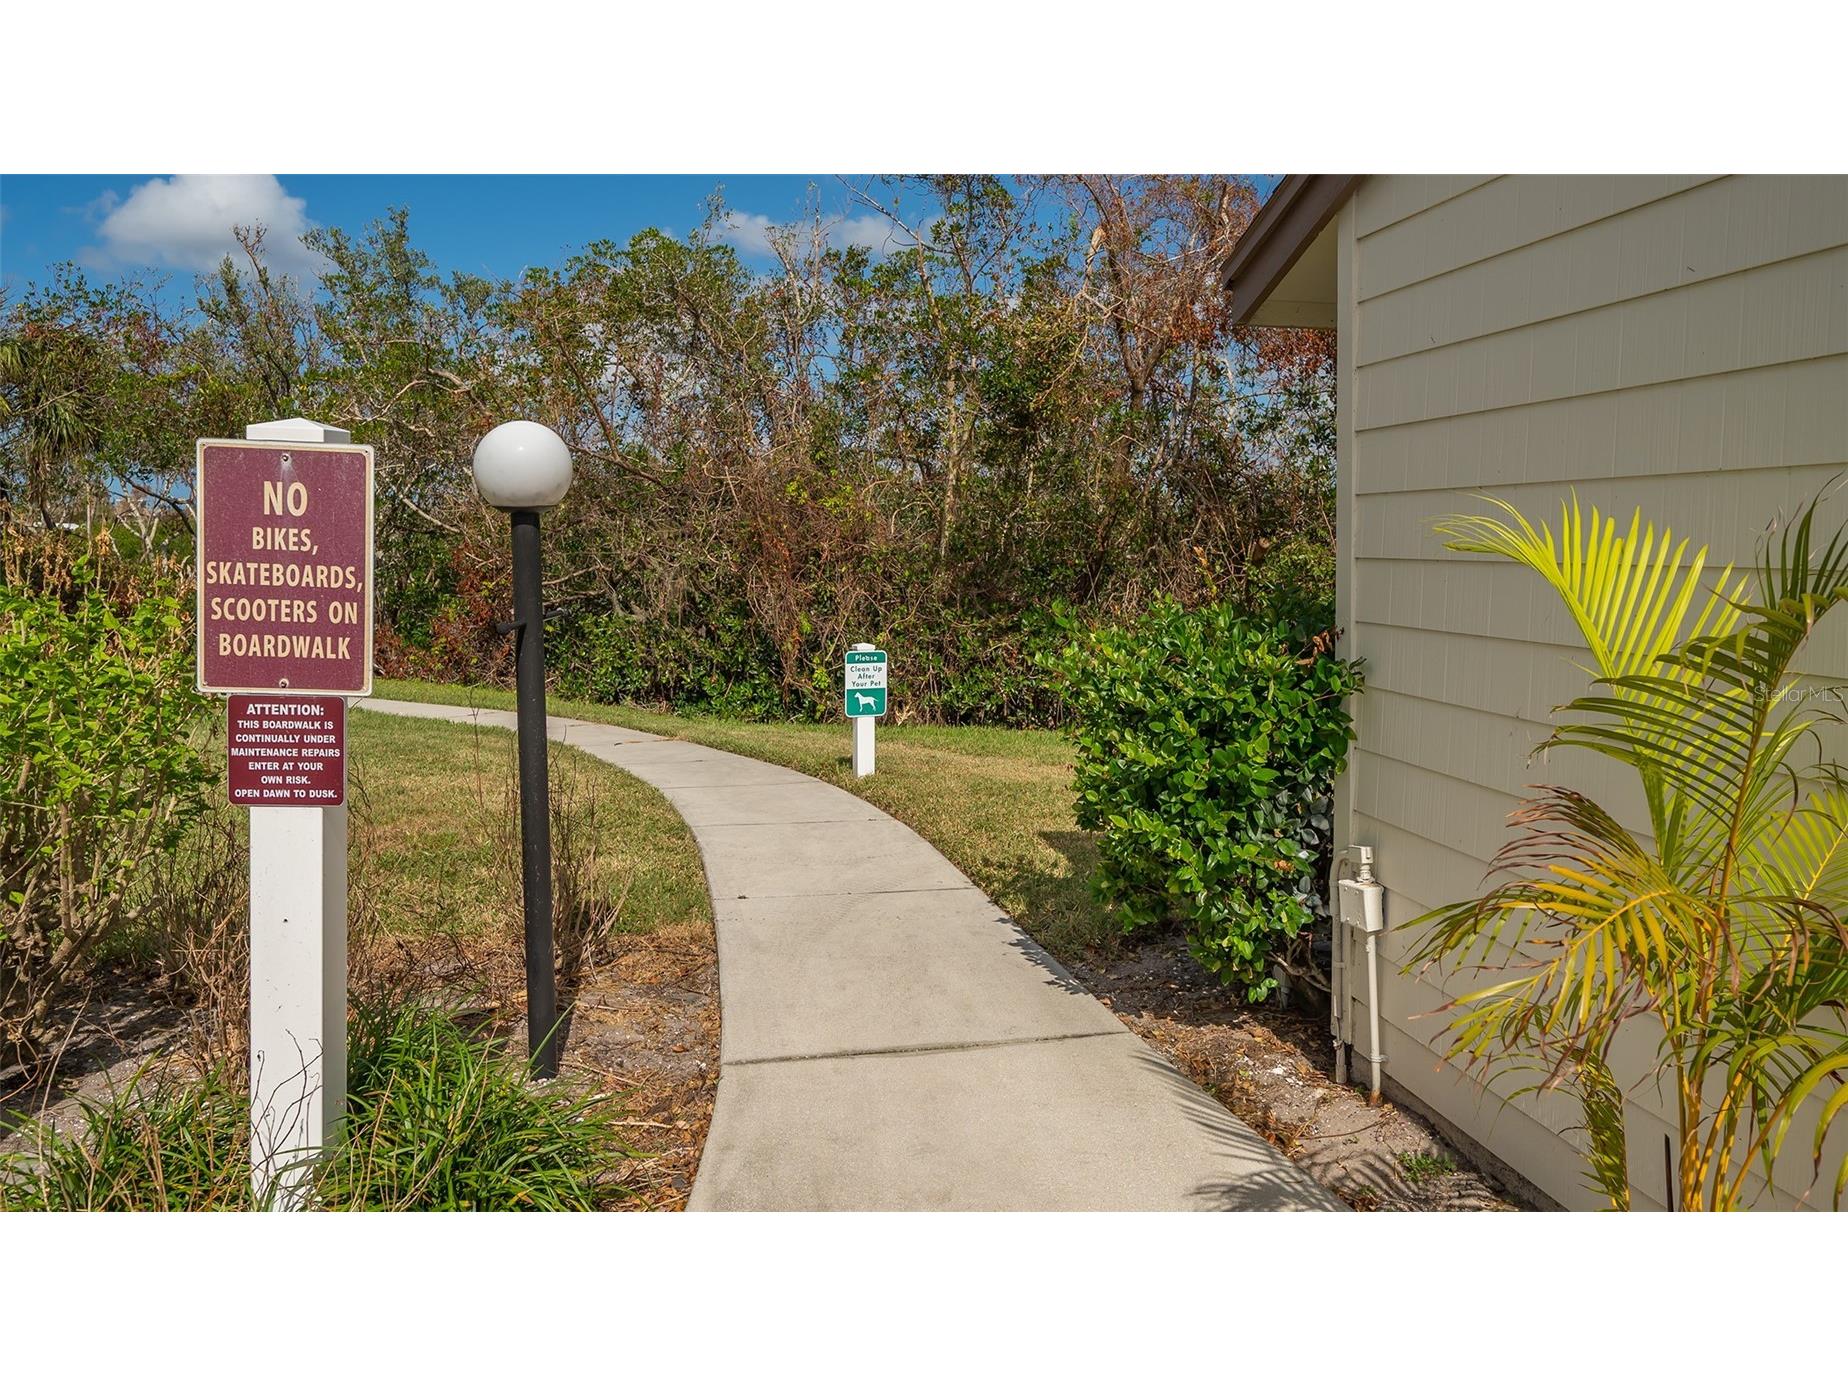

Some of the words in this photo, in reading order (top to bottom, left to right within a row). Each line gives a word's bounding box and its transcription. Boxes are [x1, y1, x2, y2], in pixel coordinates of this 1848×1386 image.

[263, 481, 307, 517] NO
[252, 527, 318, 555] BIKES,
[206, 561, 363, 592] SKATEBOARDS,
[211, 598, 317, 623] SCOOTERS
[328, 601, 358, 624] ON
[218, 633, 351, 659] BOARDWALK
[246, 704, 324, 715] ATTENTION:
[237, 720, 259, 728] THIS
[262, 721, 321, 729] BOARDWALK
[324, 721, 333, 729] IS
[235, 734, 300, 743] CONTINUALLY
[303, 735, 336, 743] UNDER
[231, 748, 298, 756] MAINTENANCE
[301, 749, 340, 757] REPAIRS
[249, 762, 279, 770] ENTER
[282, 762, 294, 770] AT
[298, 762, 323, 770] YOUR
[261, 776, 282, 784] OWN
[286, 776, 311, 784] RISK.
[235, 789, 259, 797] OPEN
[309, 790, 337, 798] DUSK.
